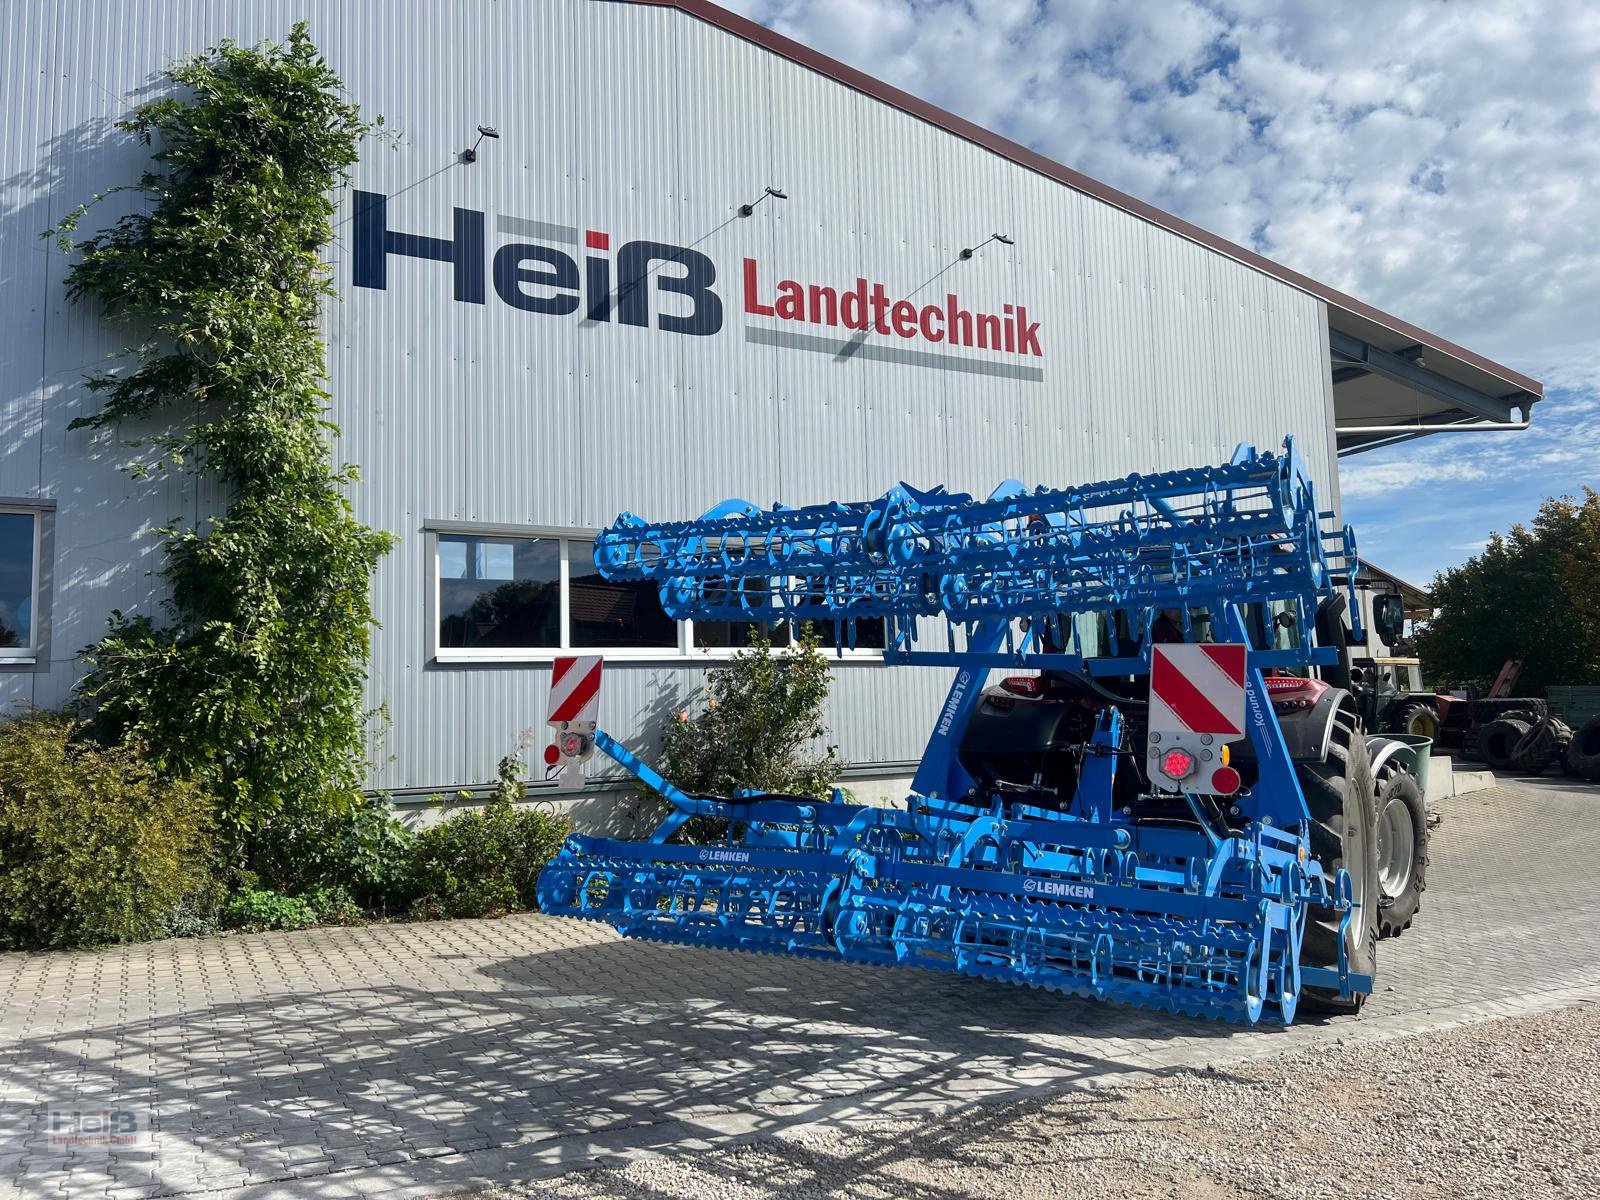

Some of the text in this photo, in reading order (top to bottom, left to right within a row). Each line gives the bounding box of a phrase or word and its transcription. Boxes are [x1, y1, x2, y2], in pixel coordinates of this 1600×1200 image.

[353, 190, 1044, 357] Heiß Landtechnik
[938, 683, 966, 736] LEMKEN
[708, 850, 750, 862] LEMKEN
[1037, 881, 1094, 899] LEMKEN
